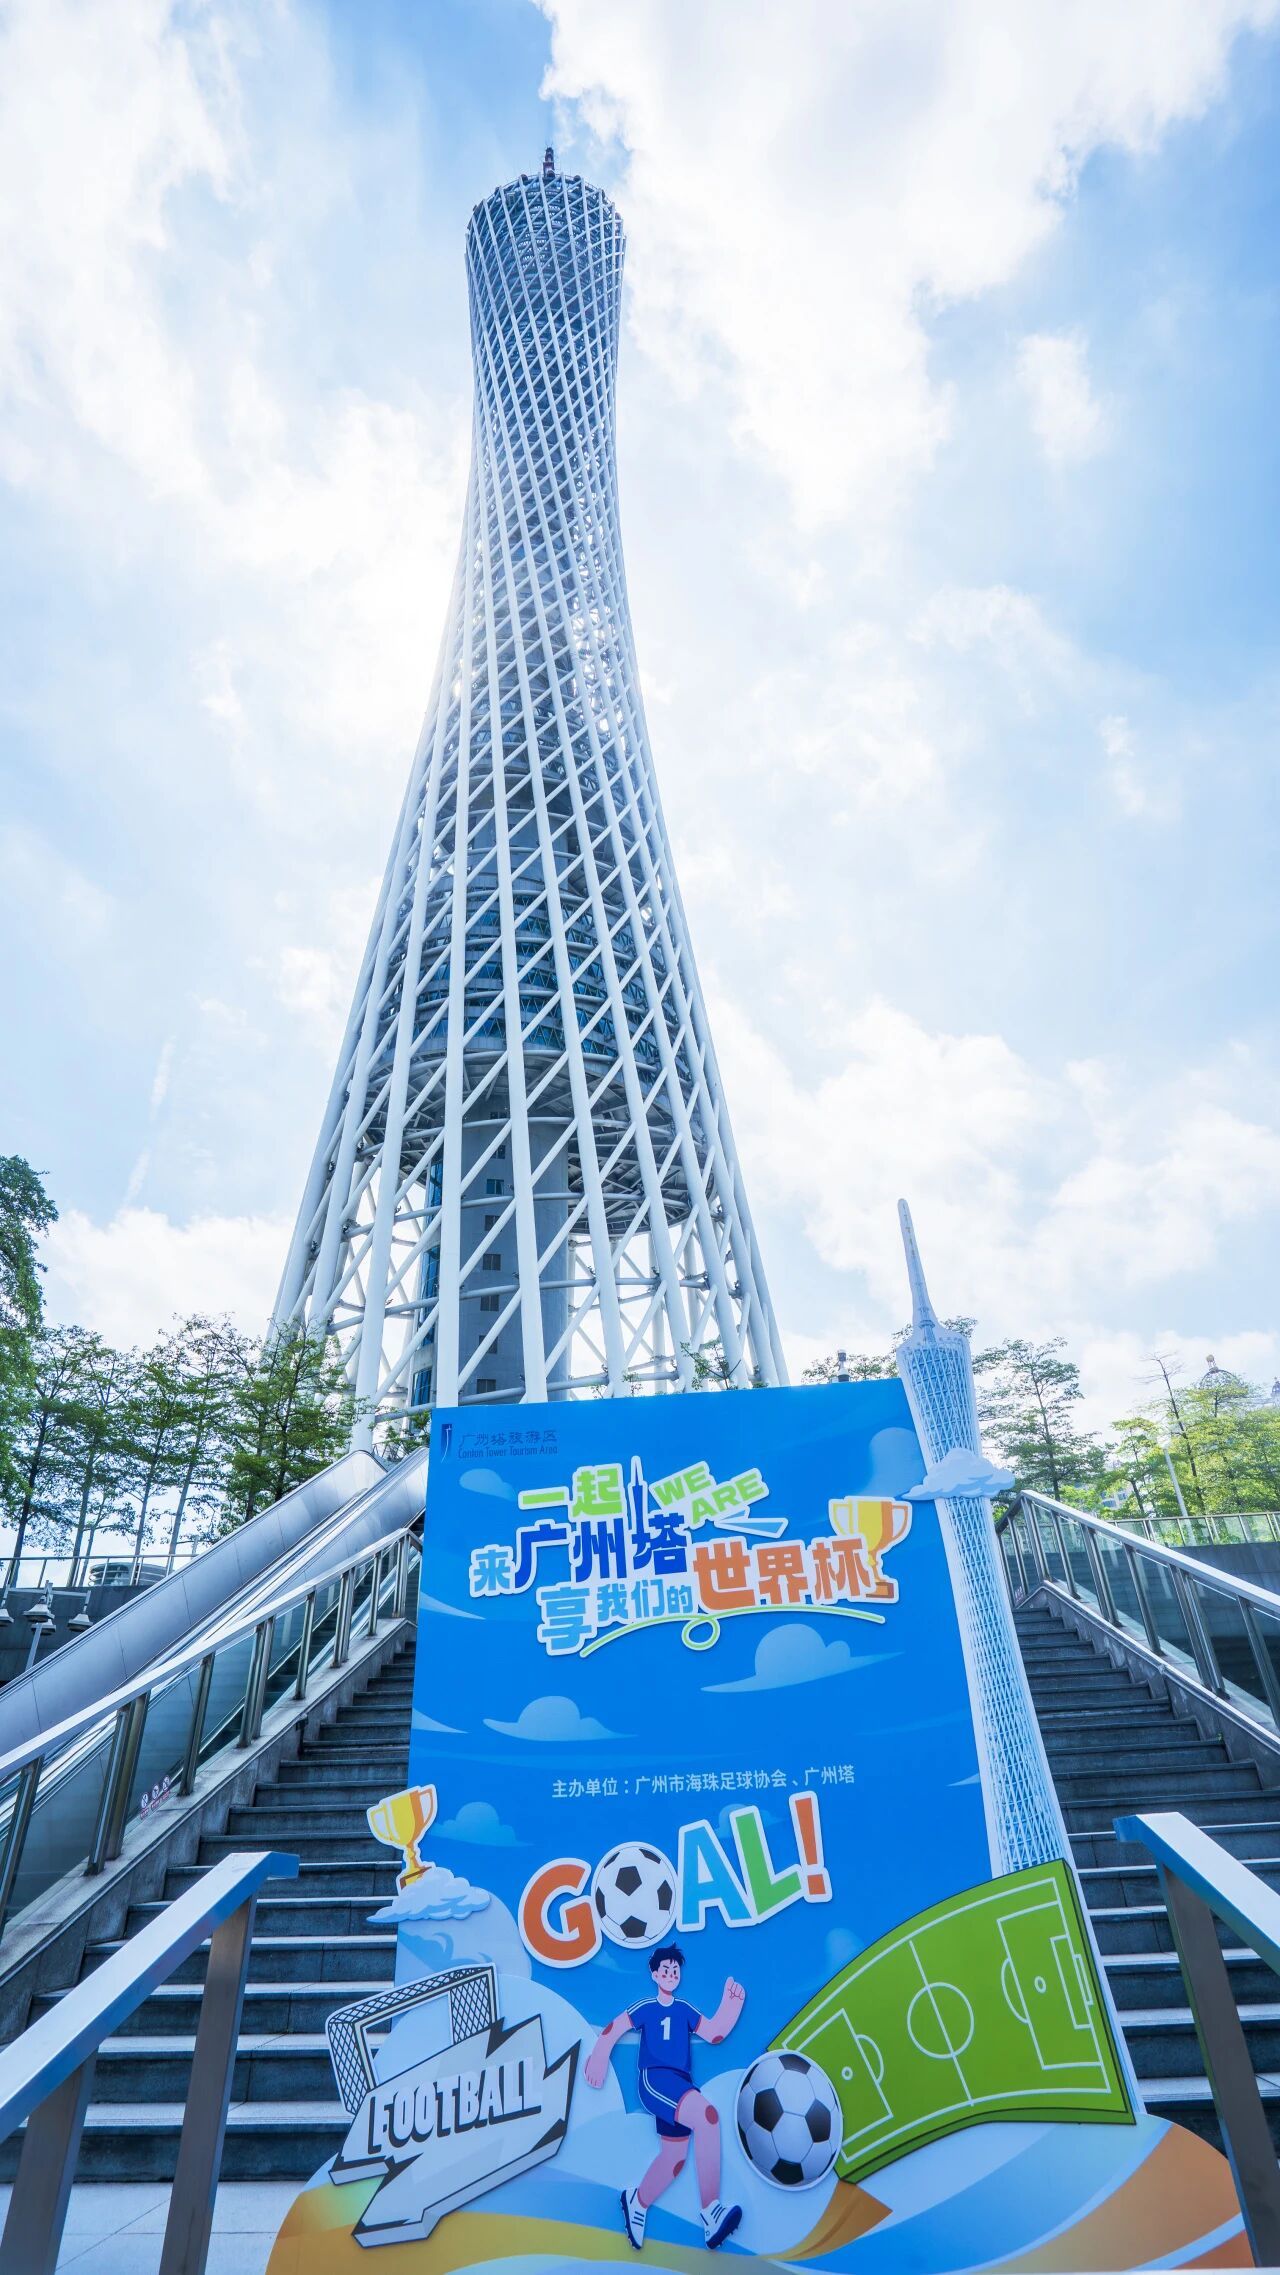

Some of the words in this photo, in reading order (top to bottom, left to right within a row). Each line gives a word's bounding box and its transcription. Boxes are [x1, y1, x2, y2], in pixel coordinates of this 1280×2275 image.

[486, 1447, 506, 1457] Tower
[509, 1446, 538, 1456] Tourism
[539, 1445, 558, 1455] Area
[522, 1467, 623, 1518] 一起
[653, 1464, 712, 1506] WE
[691, 1472, 765, 1525] ARE
[660, 2016, 671, 2041] 1
[367, 2056, 542, 2155] FOOTBALL
